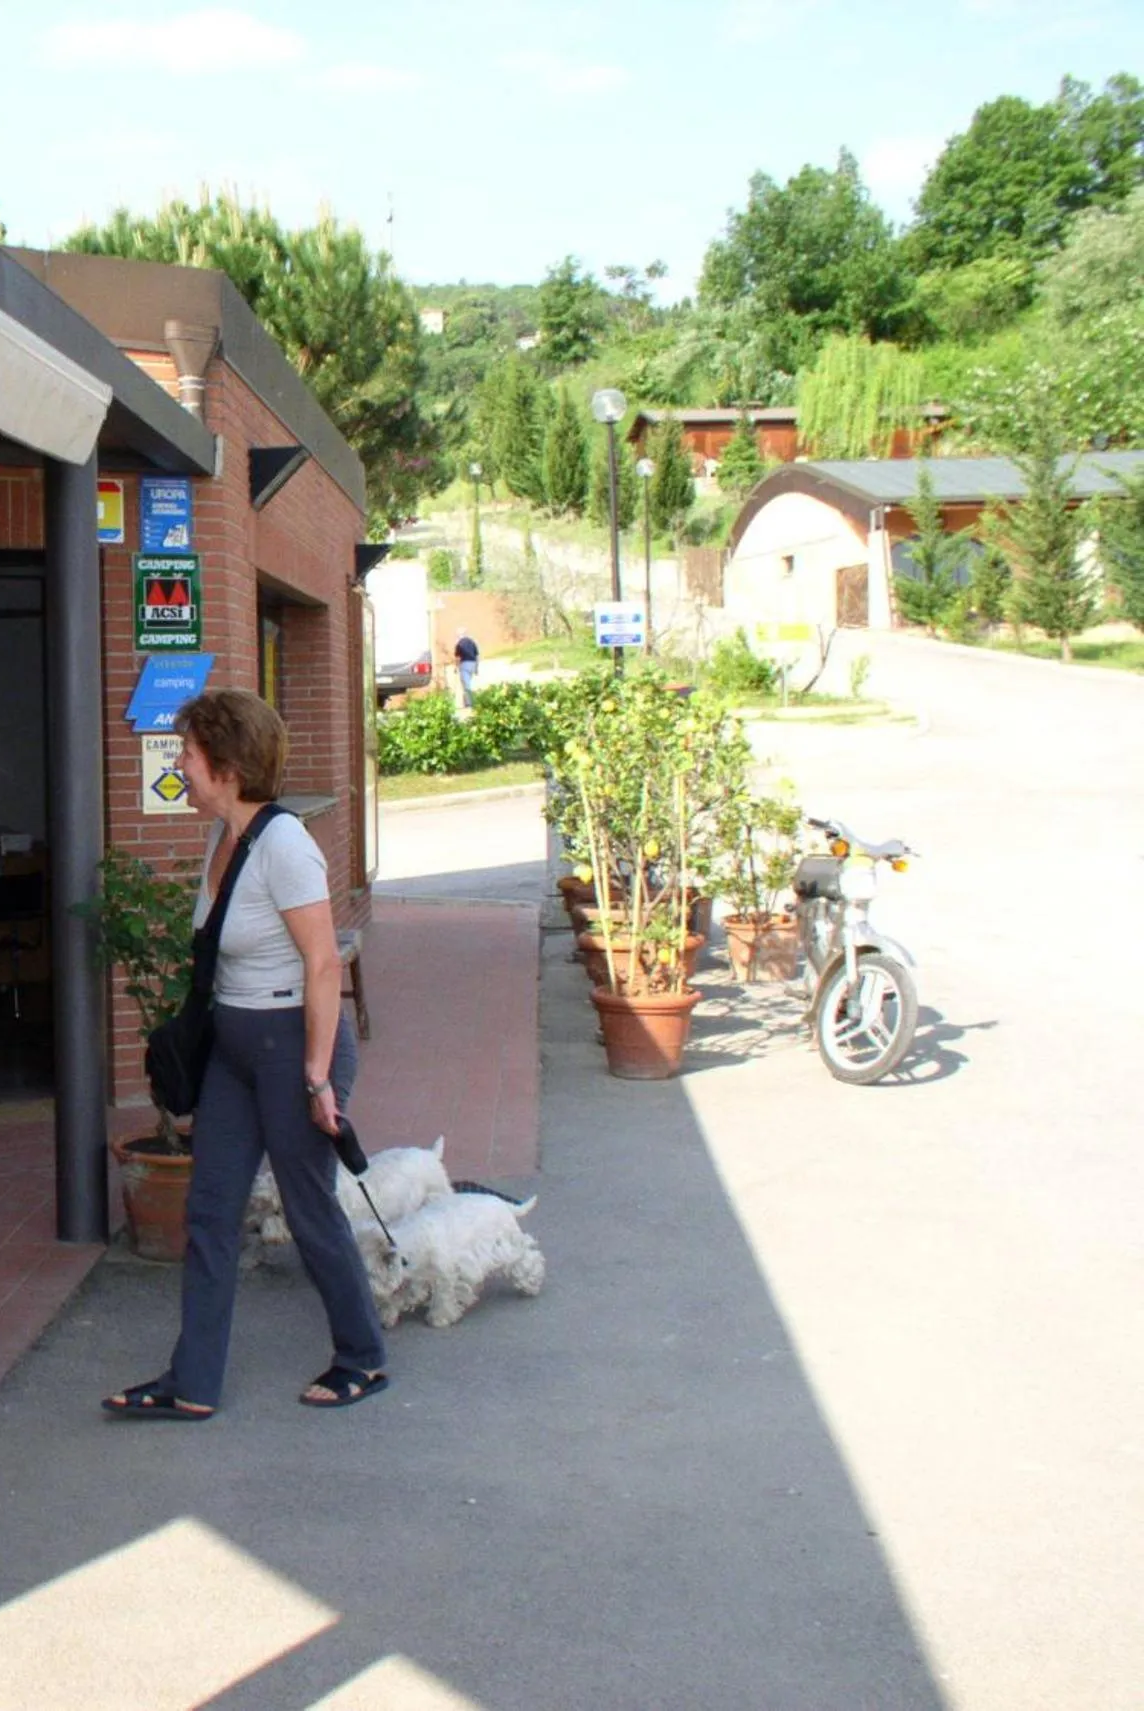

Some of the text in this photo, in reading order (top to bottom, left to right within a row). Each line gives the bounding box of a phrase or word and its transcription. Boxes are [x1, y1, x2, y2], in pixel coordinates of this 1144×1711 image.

[138, 559, 196, 571] CAMPING
[139, 633, 197, 646] CAMPING
[154, 674, 196, 690] camping
[153, 713, 177, 726] AN
[146, 740, 184, 751] CAMPI
